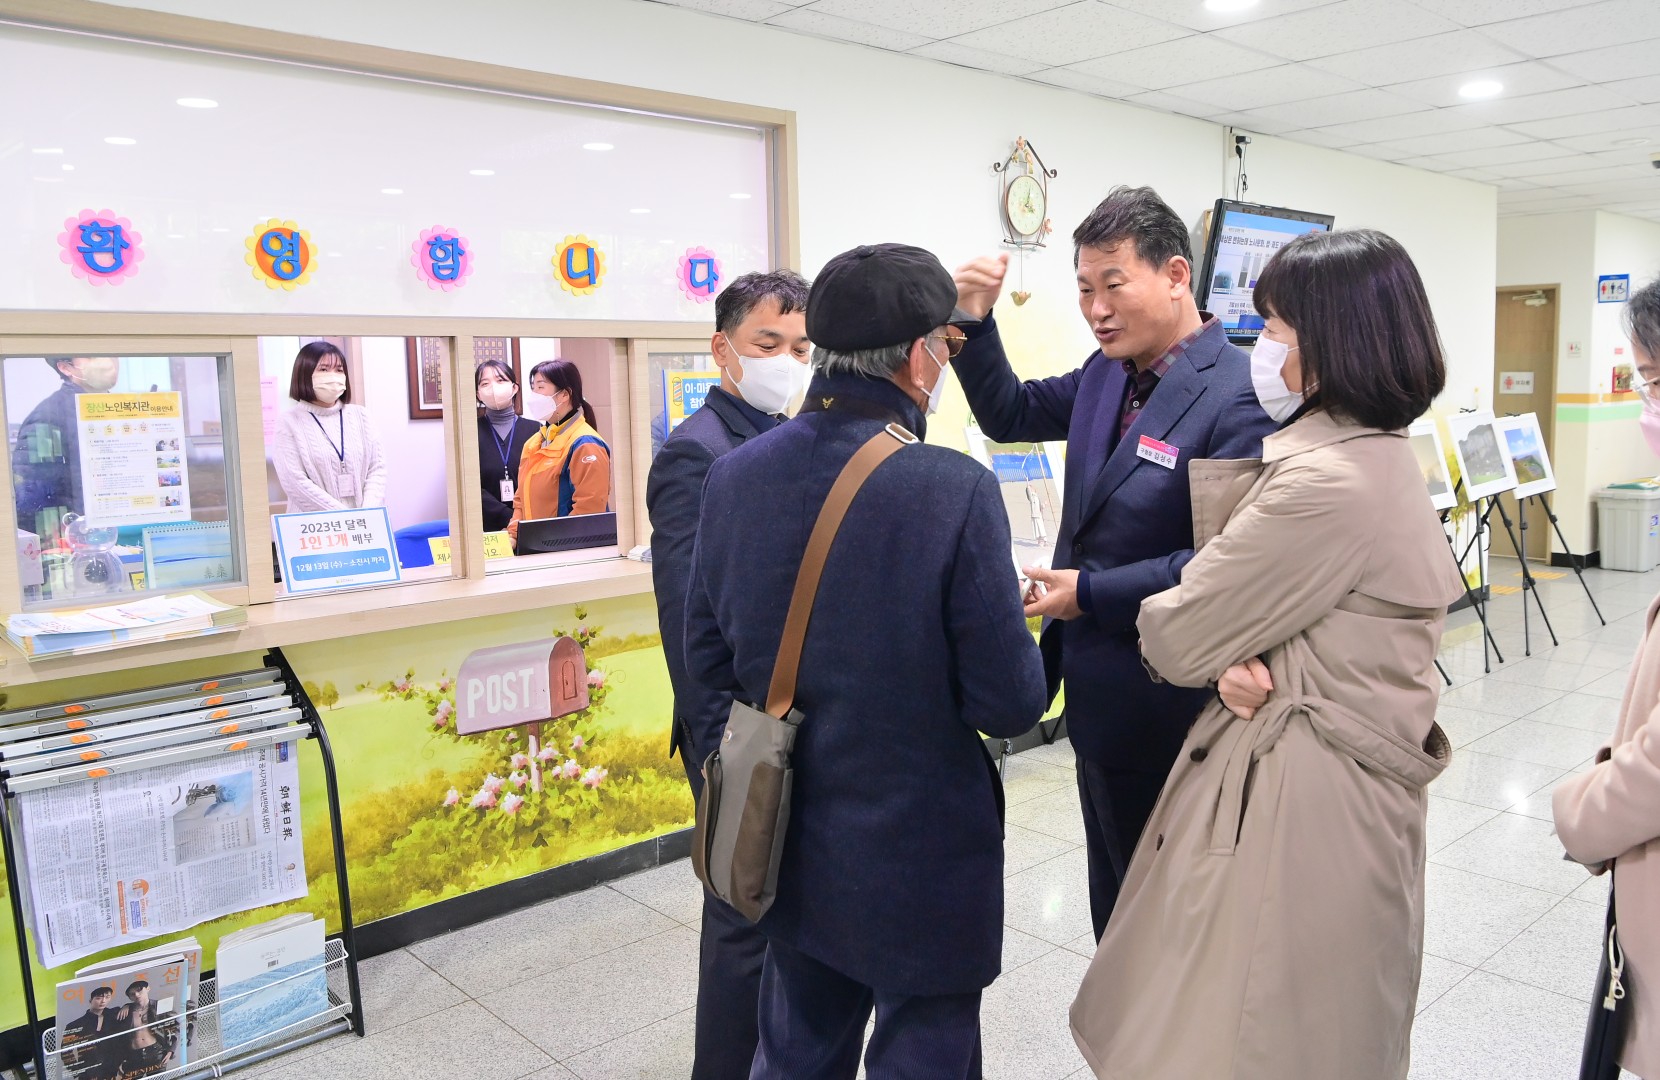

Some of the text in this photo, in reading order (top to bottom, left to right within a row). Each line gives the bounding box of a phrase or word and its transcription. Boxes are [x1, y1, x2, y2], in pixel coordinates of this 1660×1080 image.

[77, 220, 720, 293] 환 영 합 니 다
[299, 532, 374, 550] 1인 1개 배부
[300, 518, 367, 534] 2023년 달력
[296, 563, 313, 572] 12월
[313, 561, 330, 571] 13일
[330, 560, 343, 569] (수)
[349, 556, 371, 567] 소진시
[371, 555, 386, 565] 까지
[467, 667, 534, 719] POST
[279, 785, 293, 841] 朝鮮日報
